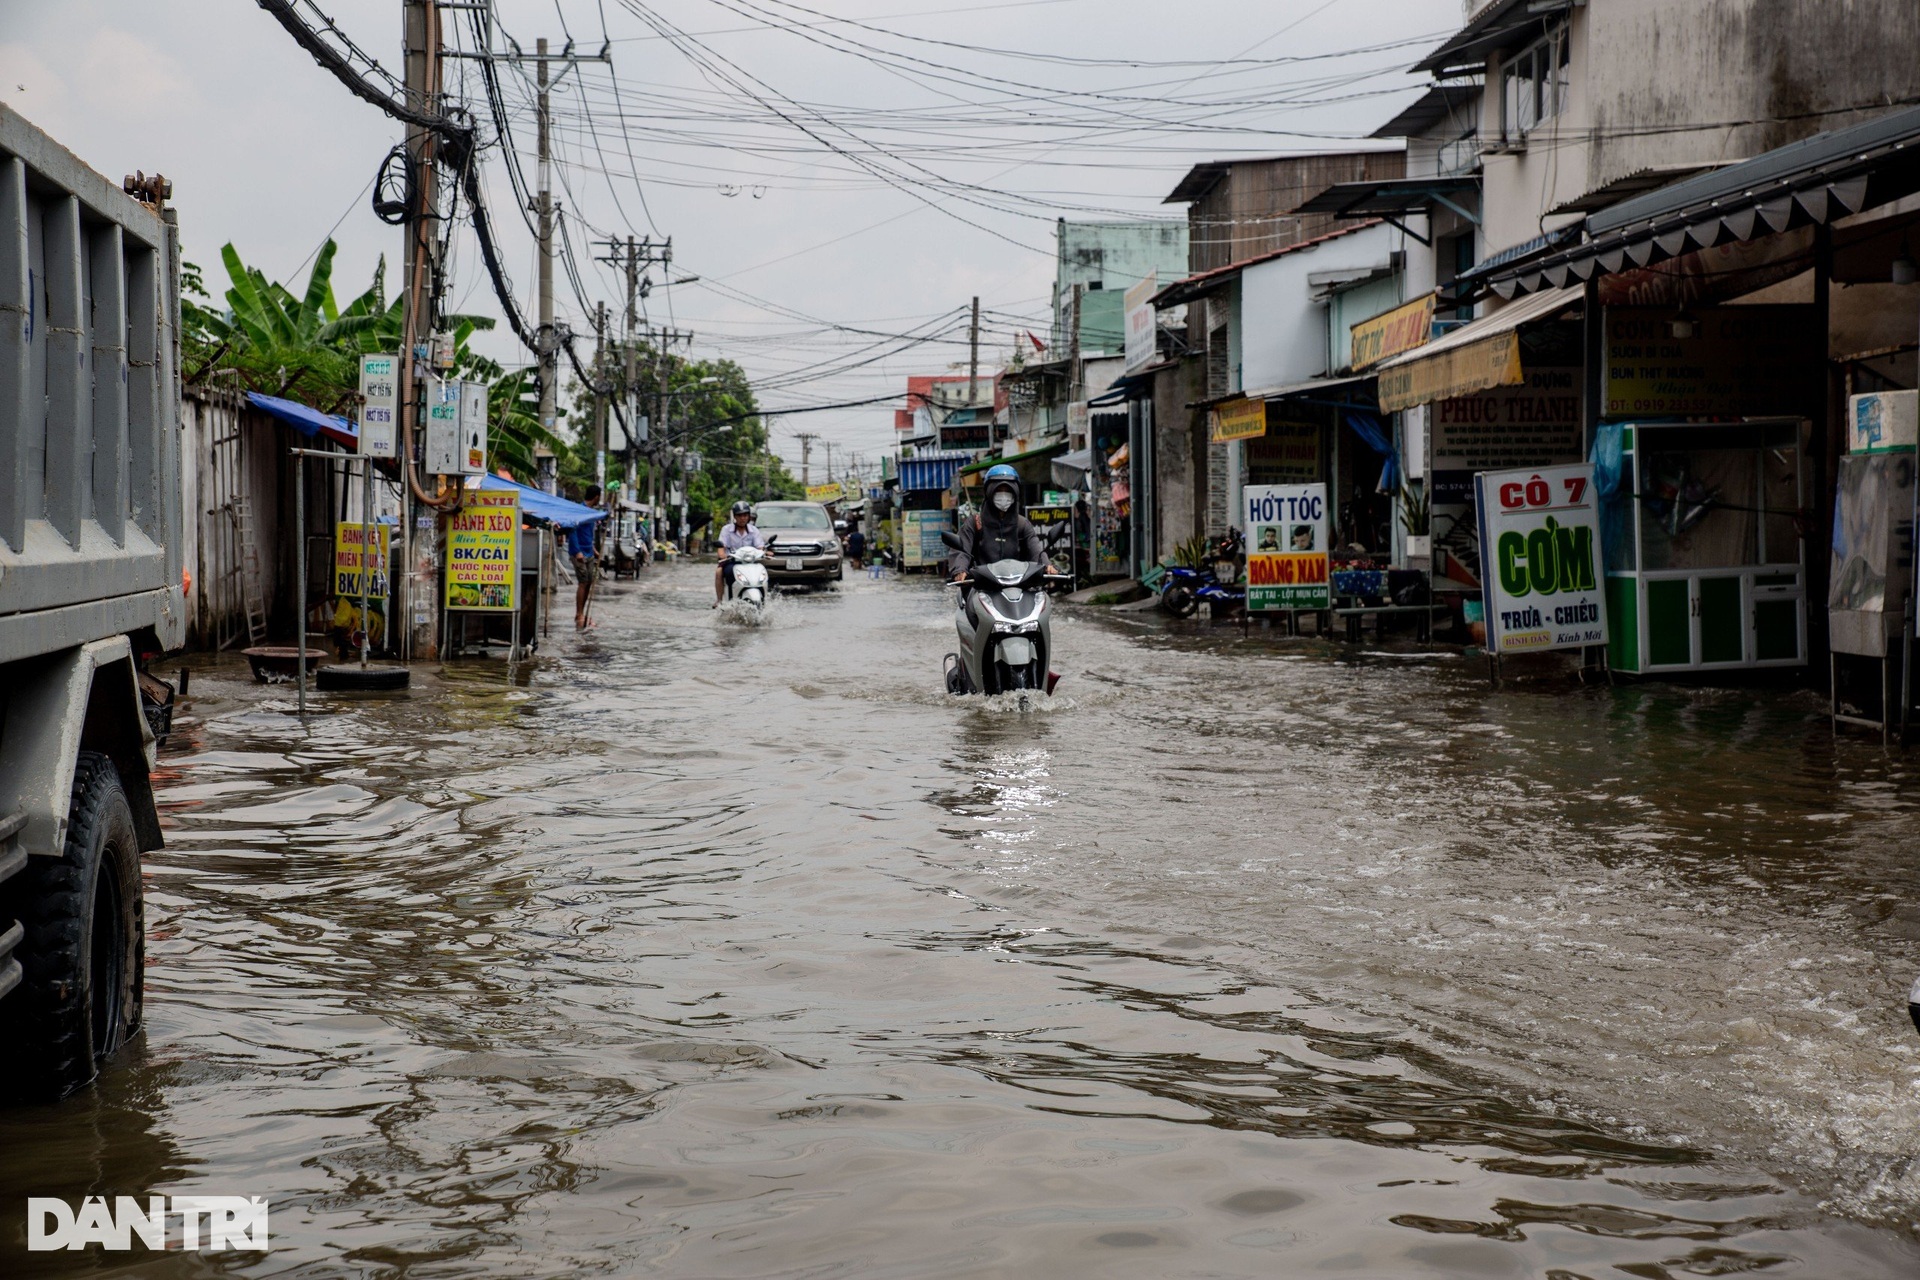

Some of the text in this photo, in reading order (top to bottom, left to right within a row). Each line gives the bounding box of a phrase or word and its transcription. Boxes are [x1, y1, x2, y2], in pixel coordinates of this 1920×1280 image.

[1441, 393, 1498, 422] PHÚC
[1500, 475, 1587, 508] CÔ 7
[1250, 490, 1322, 521] HỚT TÓC
[452, 510, 485, 531] BÁNH
[488, 511, 512, 531] XÈO
[480, 534, 511, 546] Trung
[453, 546, 509, 560] 8K/CÁI
[1498, 515, 1596, 597] CƠM
[451, 562, 510, 574] NƯỚC NGỌT
[1250, 555, 1294, 584] HOÀNG
[1297, 558, 1325, 583] NAM
[457, 573, 504, 584] CÁC LOẠI
[1265, 590, 1277, 599] TAI
[1501, 605, 1542, 630] TRƯA
[1554, 598, 1599, 625] CHIỀU
[1505, 633, 1549, 646] BÌNH DÂN
[1556, 629, 1603, 644] Kính Mời
